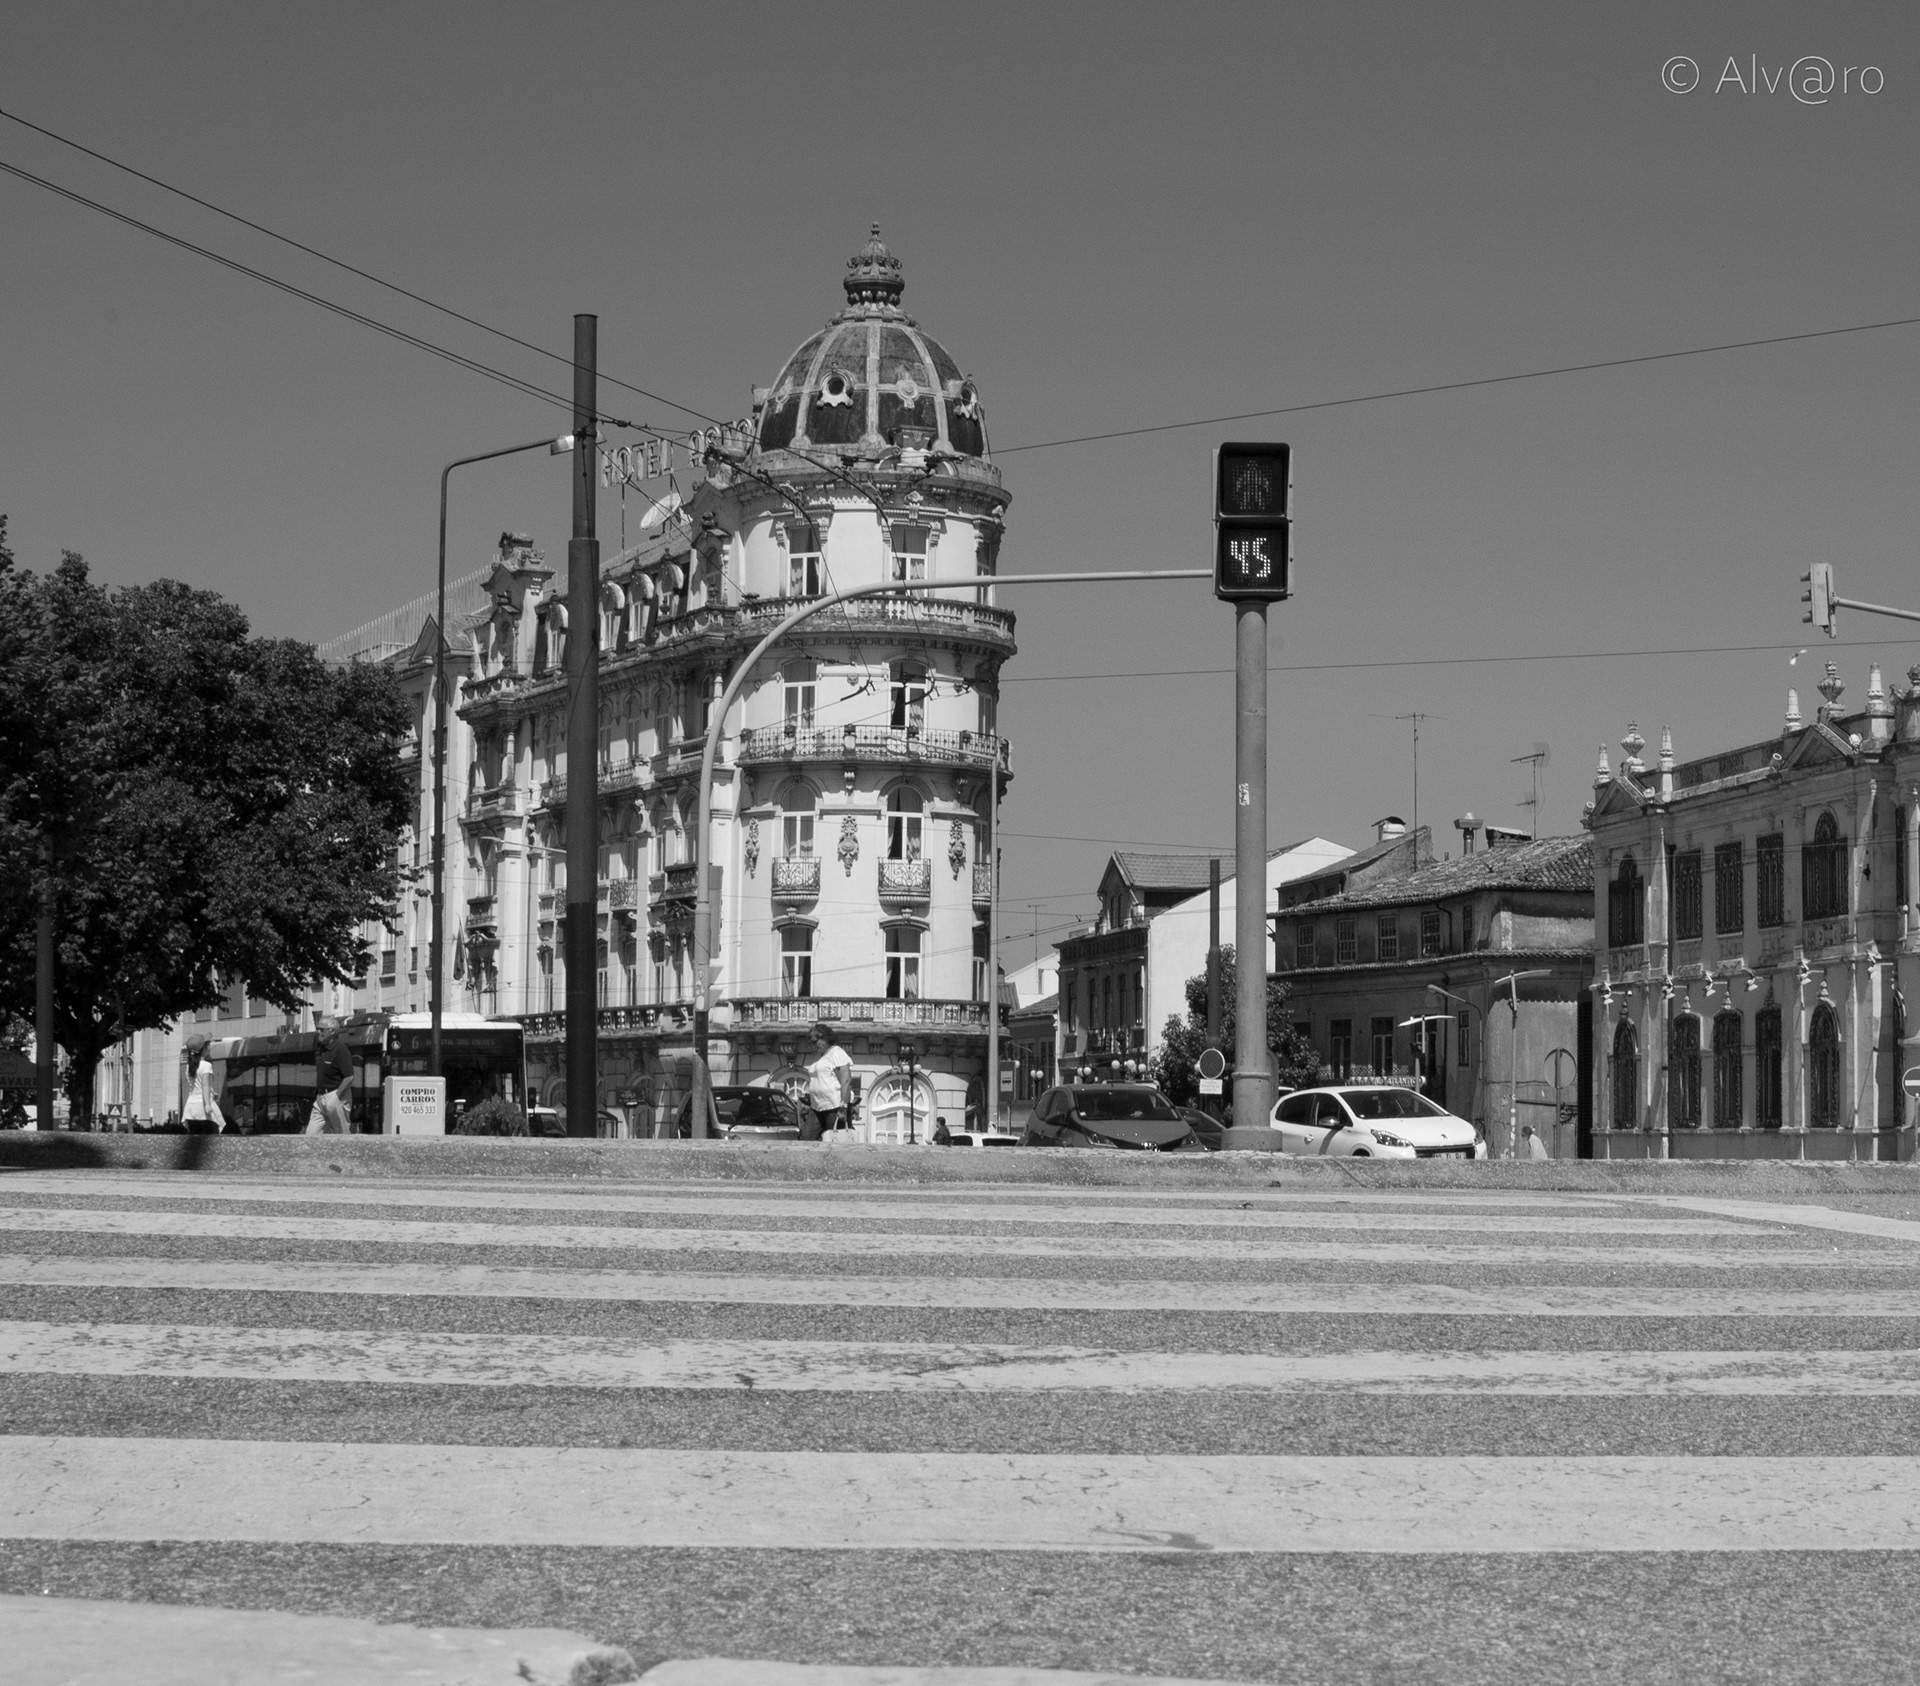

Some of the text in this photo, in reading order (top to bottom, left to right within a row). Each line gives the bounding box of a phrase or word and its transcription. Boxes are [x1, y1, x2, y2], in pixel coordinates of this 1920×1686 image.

[601, 437, 674, 489] HOTEL
[1230, 537, 1270, 578] 45
[411, 1035, 419, 1050] 6
[400, 1088, 436, 1096] COMPRO
[400, 1095, 436, 1103] CARROS
[401, 1105, 412, 1114] 920
[425, 1105, 436, 1114] 333
